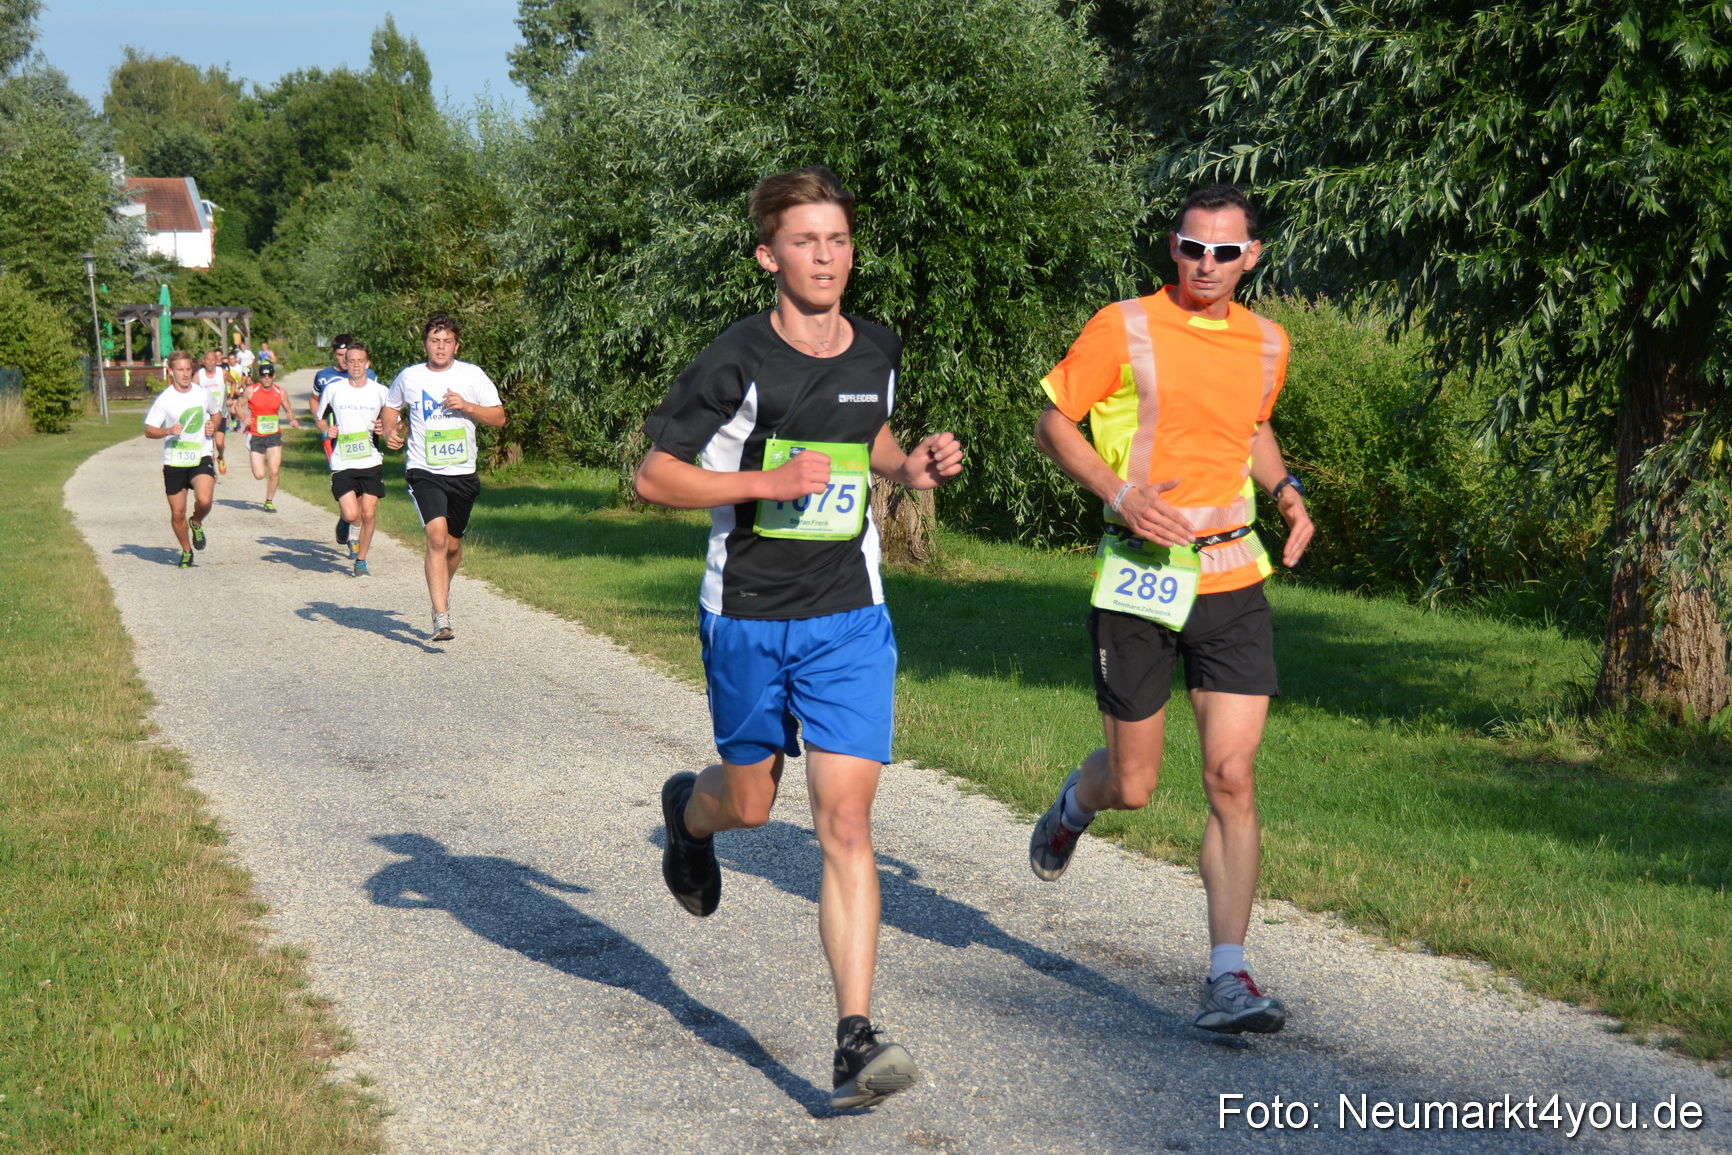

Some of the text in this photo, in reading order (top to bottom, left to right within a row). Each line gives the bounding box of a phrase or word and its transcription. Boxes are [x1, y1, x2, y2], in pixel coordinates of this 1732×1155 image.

[261, 422, 275, 430] 962
[345, 442, 365, 454] 286
[431, 442, 464, 456] 1464
[178, 451, 196, 461] 130
[789, 518, 811, 526] Stefan
[1114, 567, 1178, 604] 289
[1113, 599, 1141, 611] Reinhard
[1141, 606, 1171, 617] Zahradnik
